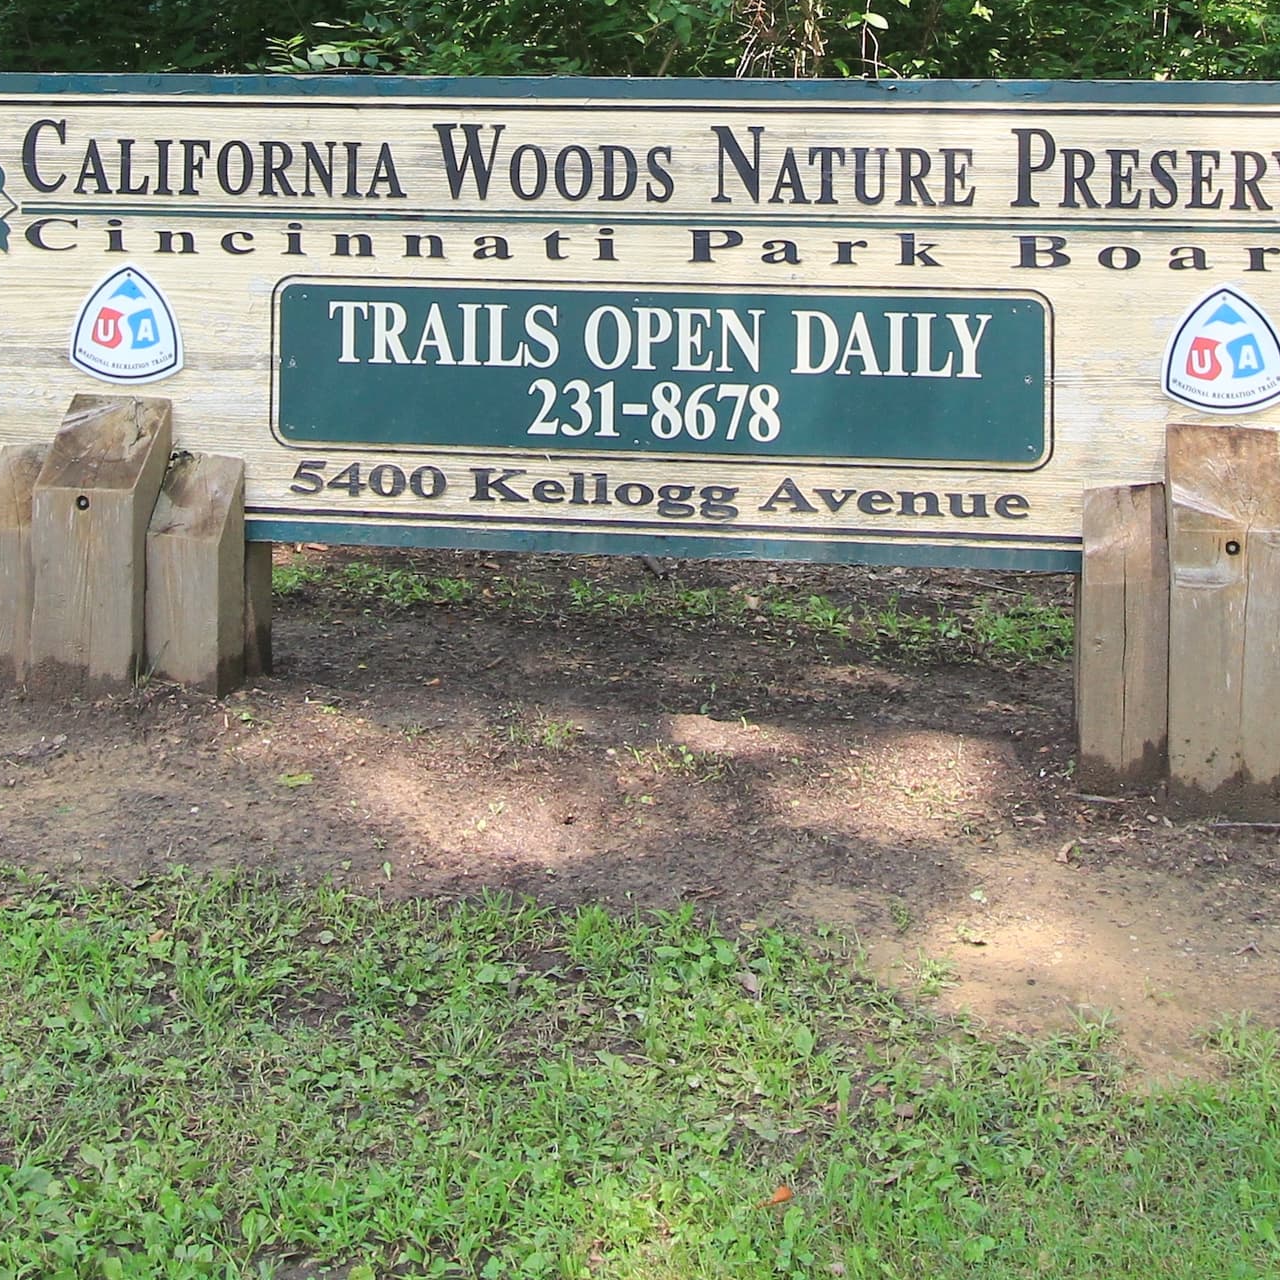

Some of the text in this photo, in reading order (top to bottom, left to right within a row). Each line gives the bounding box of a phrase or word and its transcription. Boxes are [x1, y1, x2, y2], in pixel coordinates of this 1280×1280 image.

[21, 119, 407, 199] CALIFORNIA
[432, 123, 674, 203] WOODS
[710, 126, 976, 207] NATURE
[24, 218, 618, 262] Cincinnati
[688, 228, 942, 268] Park
[328, 301, 993, 379] TRAILS OPEN DAILY
[526, 378, 782, 443] 231-8678
[290, 460, 1030, 520] 5400 Kellogg Avenue
